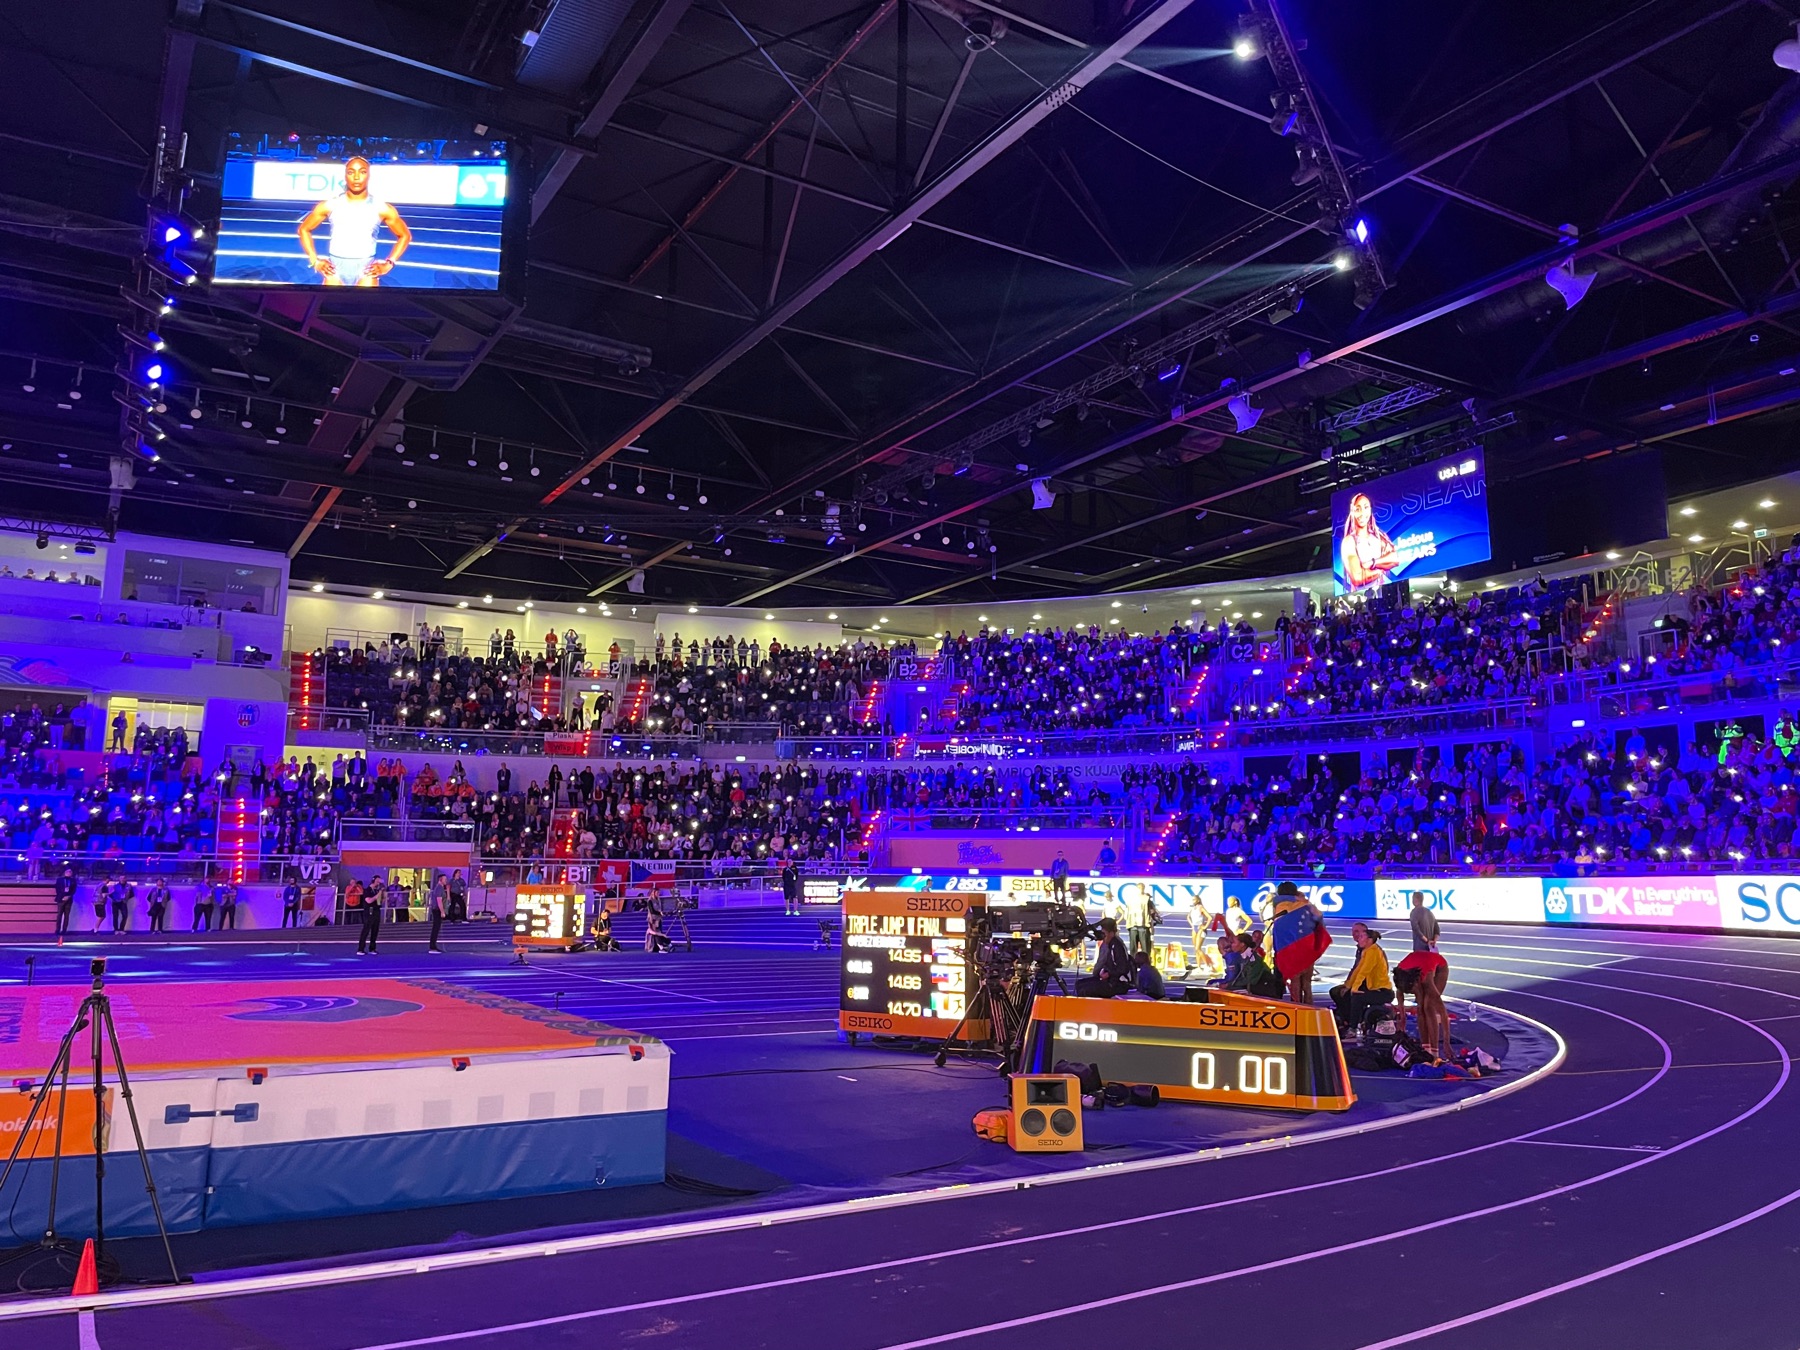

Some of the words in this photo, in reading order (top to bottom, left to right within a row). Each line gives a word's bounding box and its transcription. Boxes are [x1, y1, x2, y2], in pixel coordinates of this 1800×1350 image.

[1438, 467, 1458, 481] USA
[1665, 566, 1691, 585] E2
[1231, 644, 1253, 659] C2
[573, 661, 593, 673] A2
[601, 662, 620, 674] B2
[900, 664, 918, 676] B2
[925, 663, 944, 676] C2
[300, 863, 332, 880] VIP
[568, 866, 587, 882] B1
[1012, 879, 1062, 891] SEIK
[906, 897, 964, 912] SEIKO
[1398, 889, 1457, 911] TDK
[1565, 887, 1633, 916] TDK
[847, 914, 878, 935] TRIPLE
[880, 915, 905, 935] JUMP
[917, 916, 943, 937] FINAL
[887, 1001, 922, 1017] 14.70
[848, 1016, 893, 1030] SEIKO
[1200, 1008, 1291, 1031] SEIKO
[1059, 1021, 1119, 1043] 60m
[1191, 1052, 1288, 1096] 0.00
